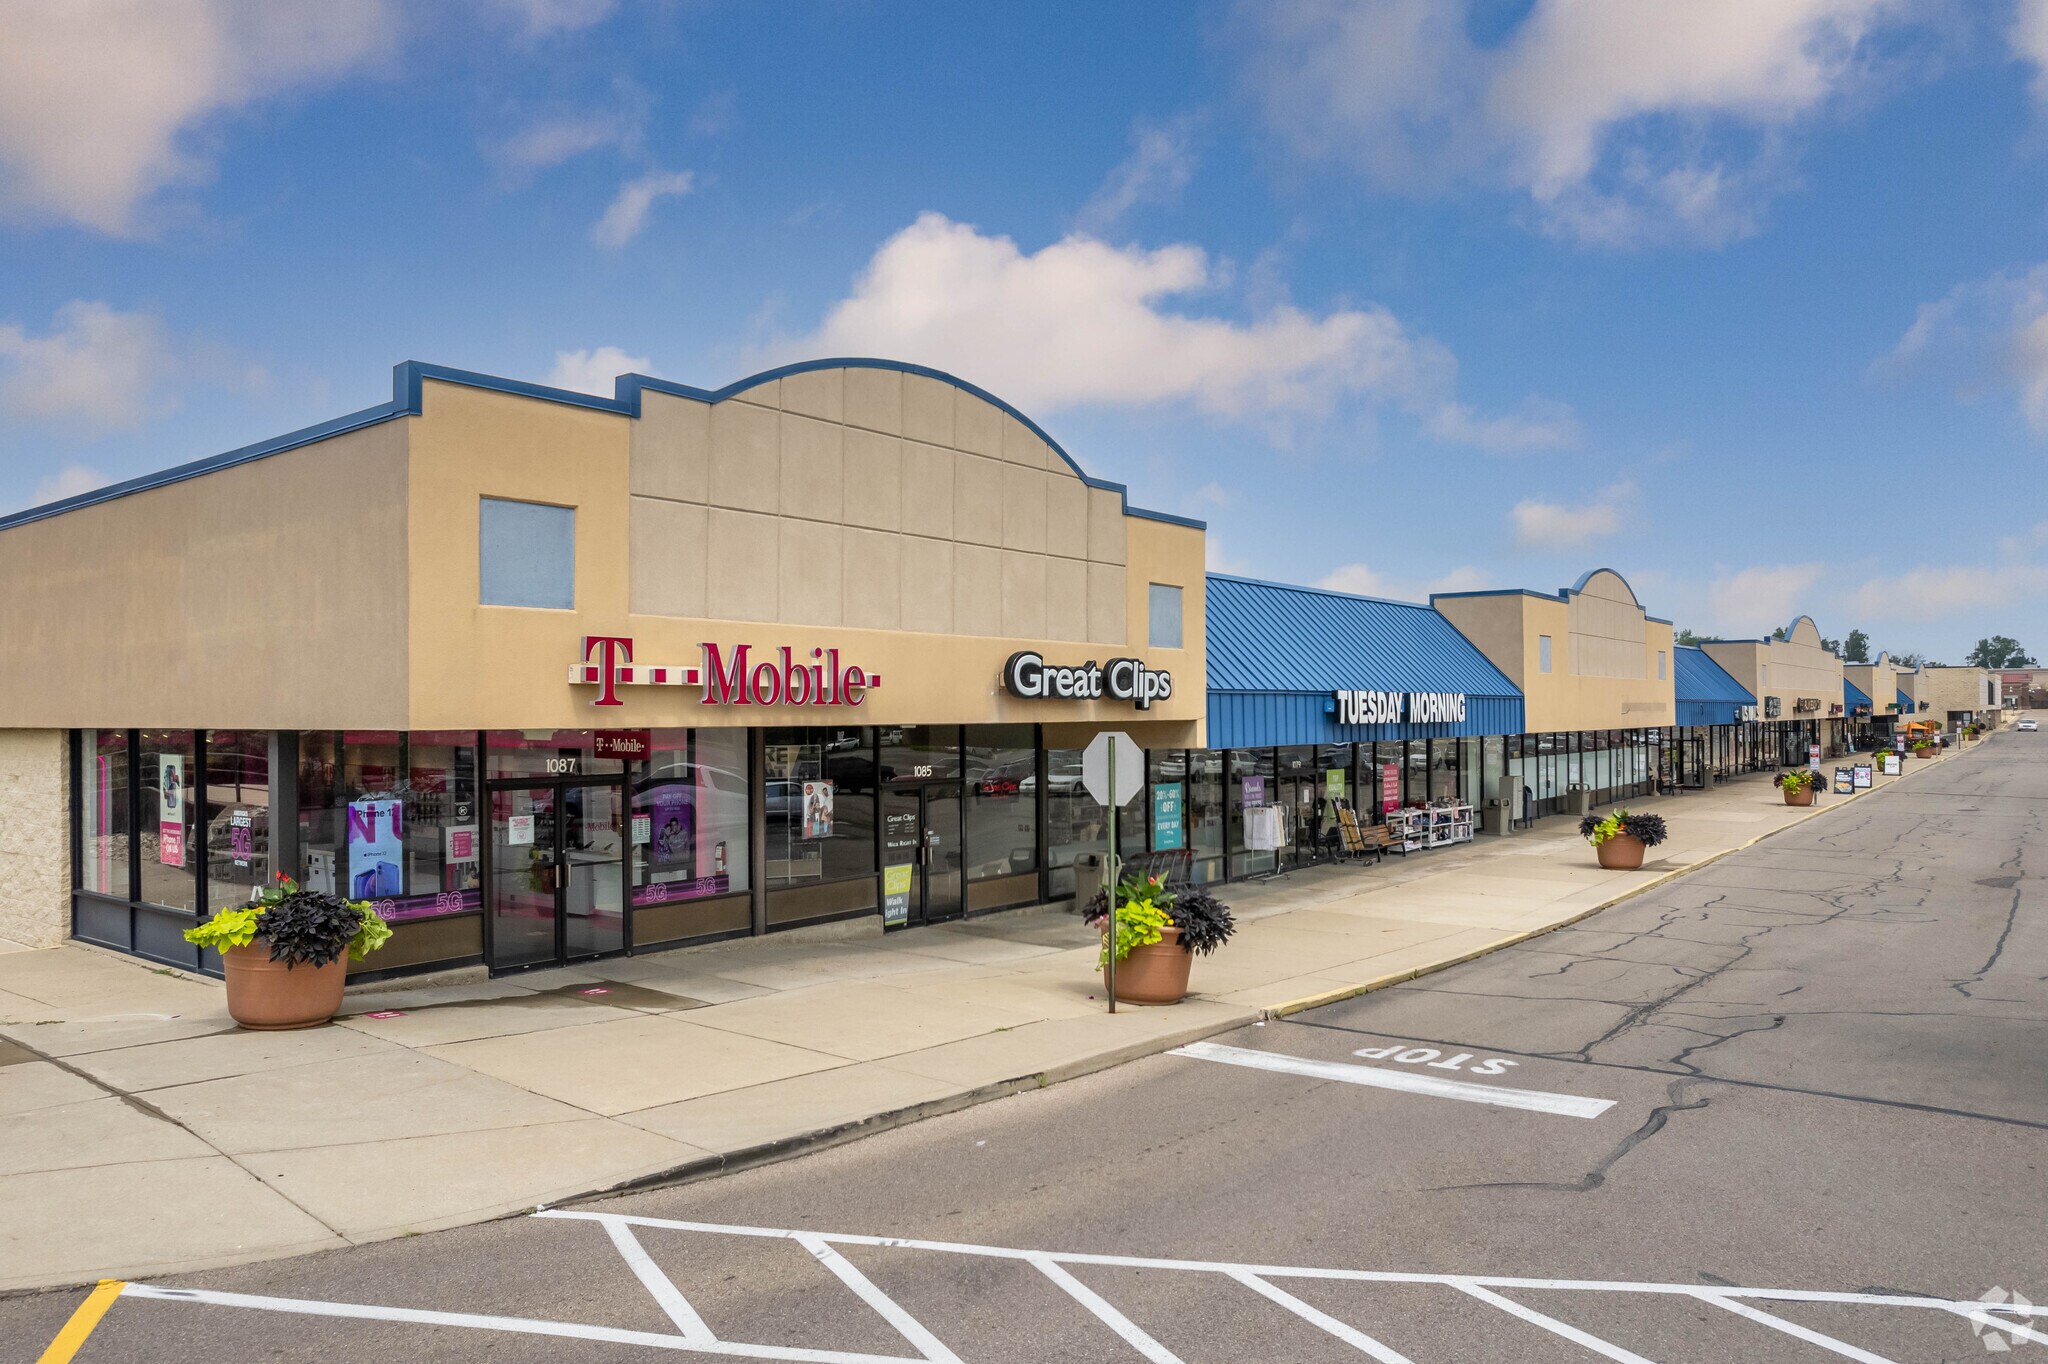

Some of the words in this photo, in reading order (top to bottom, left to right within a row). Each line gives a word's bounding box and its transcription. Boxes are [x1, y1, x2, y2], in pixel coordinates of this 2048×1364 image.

[697, 642, 867, 706] Mobile
[1012, 653, 1102, 698] Great
[1110, 661, 1172, 709] Clips
[1336, 690, 1403, 724] TUESDAY
[1410, 692, 1466, 724] MORNING
[612, 739, 642, 752] Mobile
[546, 758, 576, 773] 1087
[914, 765, 932, 778] 1085
[355, 807, 385, 819] Phne
[1162, 801, 1175, 813] OFF
[230, 816, 251, 827] LARGEST
[902, 813, 916, 821] Clips
[231, 828, 251, 860] 5G
[886, 870, 909, 881] Great
[646, 882, 668, 902] 5G
[696, 876, 716, 896] 5G
[886, 880, 907, 892] Clips
[436, 890, 464, 913] 5G
[886, 896, 903, 906] Walk
[371, 899, 396, 920] 5G
[900, 906, 908, 915] In
[1352, 1045, 1520, 1075] STOP
